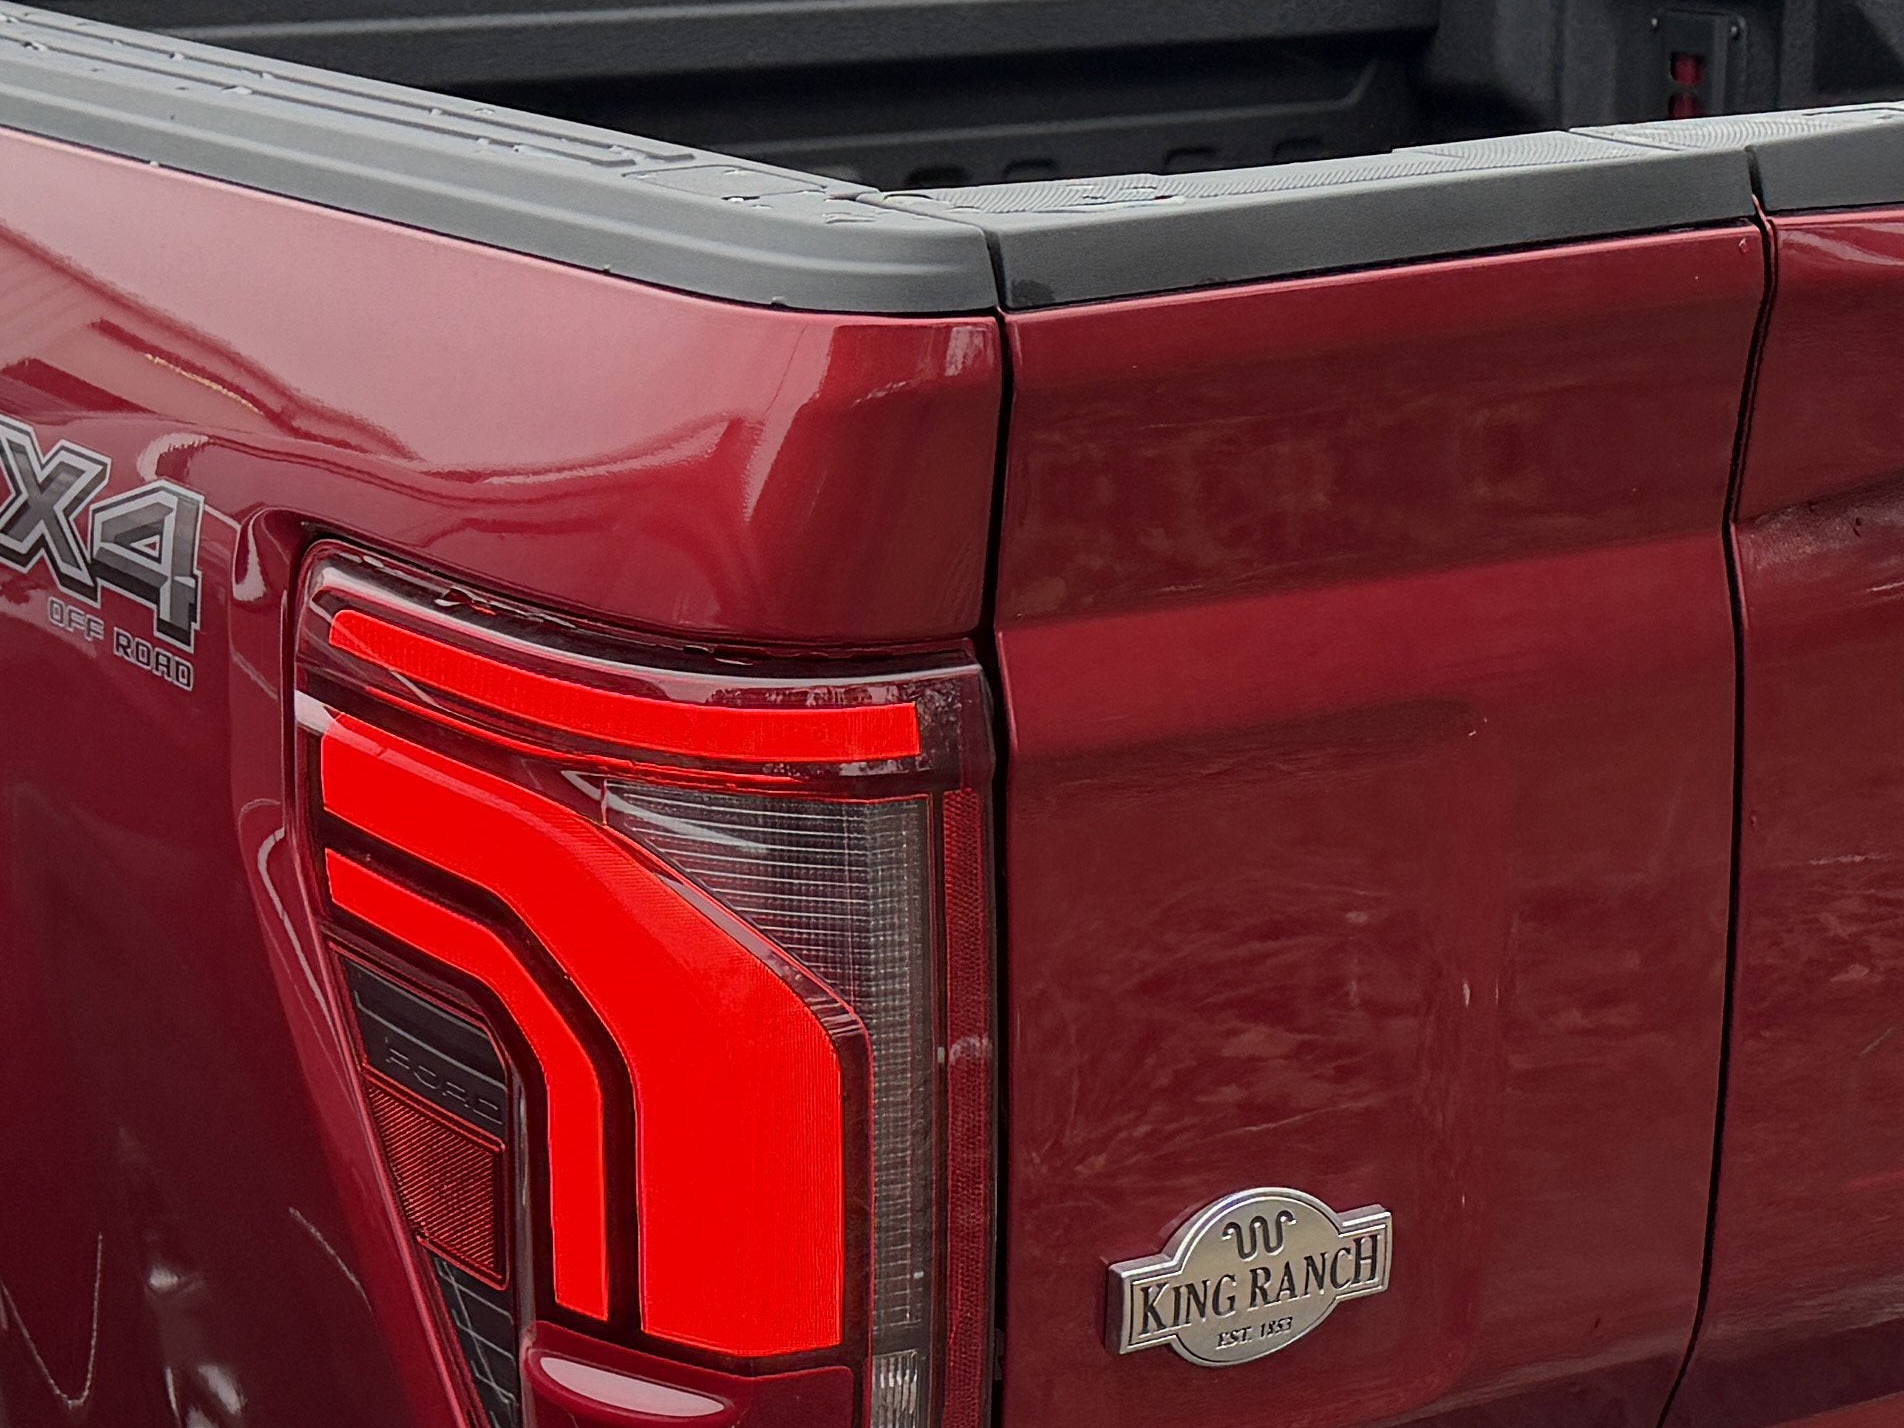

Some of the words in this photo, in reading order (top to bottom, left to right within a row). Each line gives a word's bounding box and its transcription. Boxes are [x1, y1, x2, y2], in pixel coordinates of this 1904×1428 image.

[48, 597, 105, 640] OFF
[113, 626, 194, 691] ROAD
[383, 1036, 504, 1125] FORD
[1139, 1273, 1237, 1338] KING
[1247, 1233, 1381, 1311] RANCH
